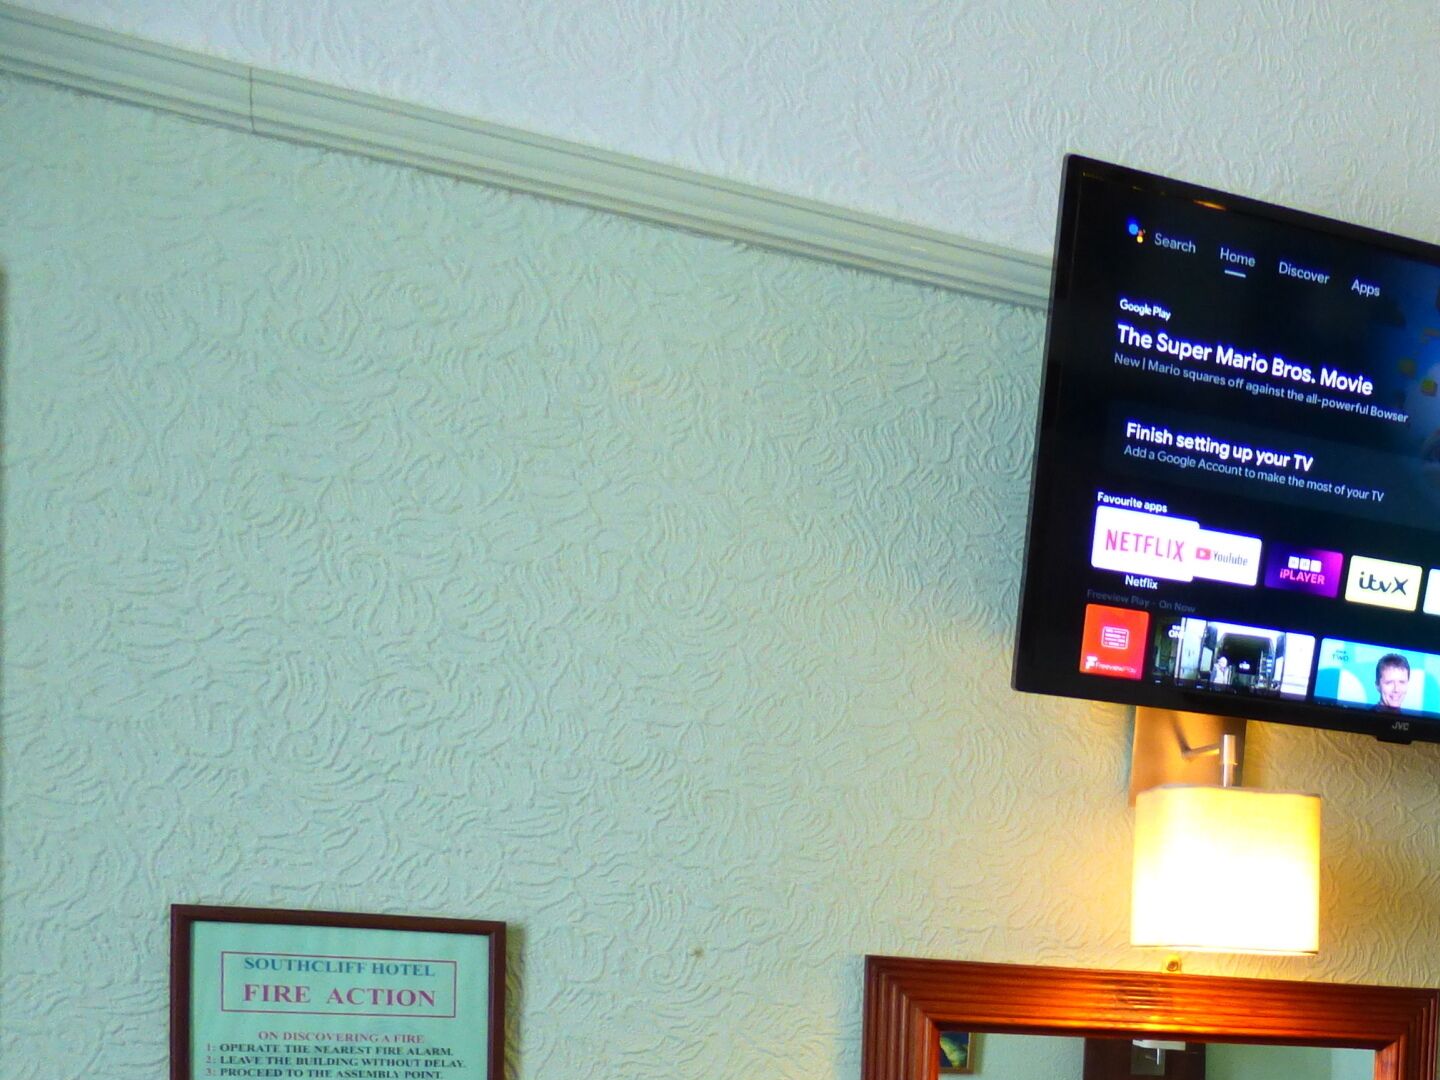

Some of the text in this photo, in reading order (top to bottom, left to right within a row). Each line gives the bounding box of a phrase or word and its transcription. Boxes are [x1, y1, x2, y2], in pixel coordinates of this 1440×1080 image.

[1154, 232, 1196, 253] Search
[1220, 248, 1255, 267] Home
[1279, 261, 1330, 284] Discover
[1351, 279, 1380, 297] Apps
[1119, 299, 1171, 321] Google Play
[1117, 324, 1373, 395] The Super Mario Bros. Movie
[1114, 352, 1140, 368] New
[1148, 360, 1180, 376] Mario
[1183, 368, 1226, 386] squares
[1228, 376, 1244, 389] off
[1246, 380, 1285, 398] against
[1287, 389, 1304, 402] the
[1306, 393, 1369, 415] all-powerful
[1370, 406, 1409, 423] Bowser
[1126, 422, 1314, 472] Finish setting up your TV
[1123, 444, 1385, 502] Add a Google Account to make the most of your TV
[1097, 491, 1168, 514] Favourite apps
[1105, 528, 1185, 563] NETFLIX
[1213, 549, 1248, 567] YouTube
[1125, 575, 1158, 590] Netflix
[1279, 568, 1326, 585] iPLAYER
[1358, 571, 1409, 596] itvX
[1087, 588, 1130, 603] Freeview
[1131, 595, 1150, 608] Play
[1159, 600, 1172, 610] On
[1174, 602, 1196, 613] Now
[1391, 721, 1409, 731] JVC
[244, 957, 435, 976] SOUTHCLIFF HOTEL
[243, 984, 436, 1007] FIRE ACTION
[258, 1031, 425, 1044] ON DISCOVERING A FIRE
[219, 1043, 279, 1053] OPERATE
[284, 1044, 308, 1053] THE
[314, 1045, 372, 1054] NEAREST
[375, 1046, 404, 1055] FIRE
[406, 1047, 454, 1056] ALARM.
[220, 1055, 263, 1065] LEAVE
[267, 1056, 292, 1065] THE
[296, 1057, 358, 1066] BUILDING
[361, 1058, 420, 1067] WITHOUT
[220, 1068, 283, 1077] PROCEED
[287, 1068, 304, 1078] TO
[308, 1069, 333, 1078] THE
[336, 1070, 401, 1079] ASSEMBLY
